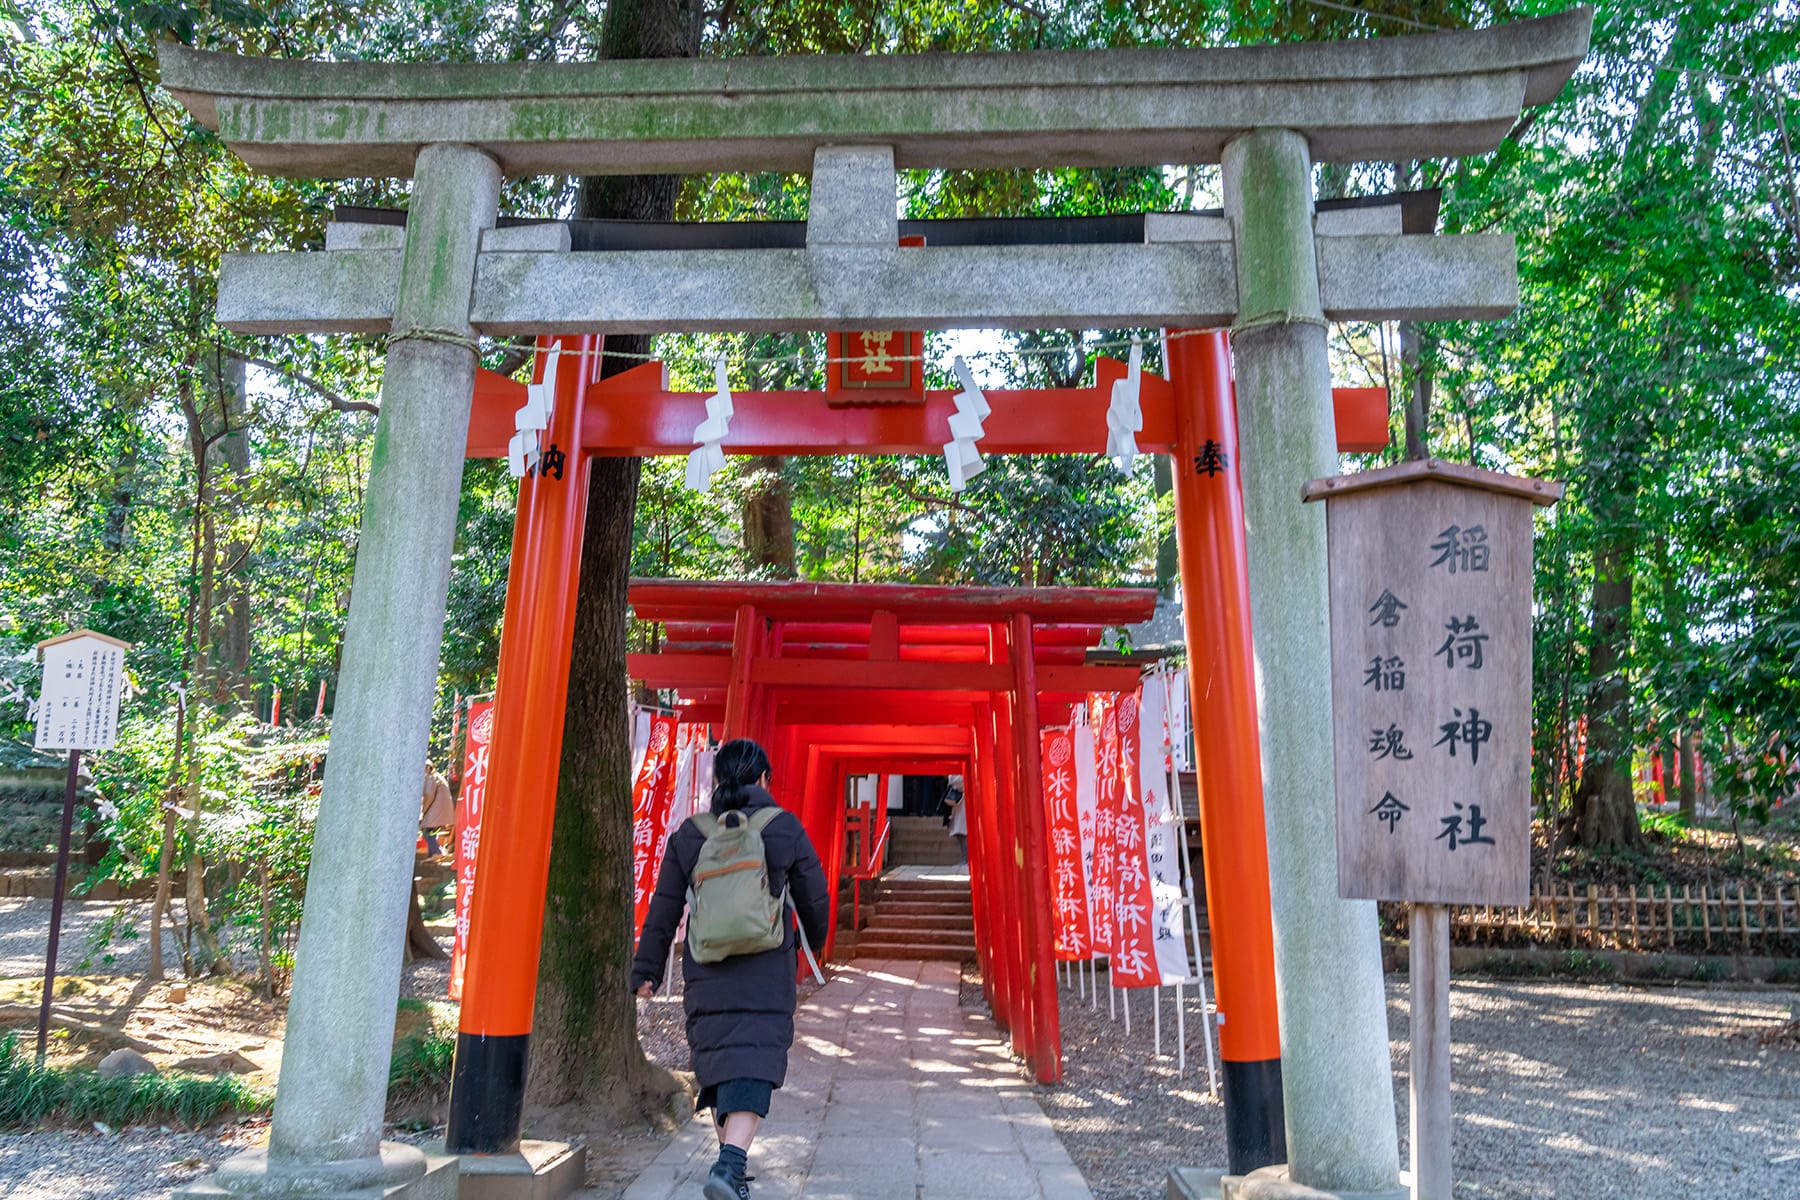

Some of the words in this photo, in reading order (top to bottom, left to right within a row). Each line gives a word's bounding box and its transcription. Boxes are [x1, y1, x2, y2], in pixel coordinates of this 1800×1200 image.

[1194, 439, 1229, 478] 奉
[1363, 588, 1414, 835] 倉稲魂命
[1430, 524, 1497, 850] 稲荷神社
